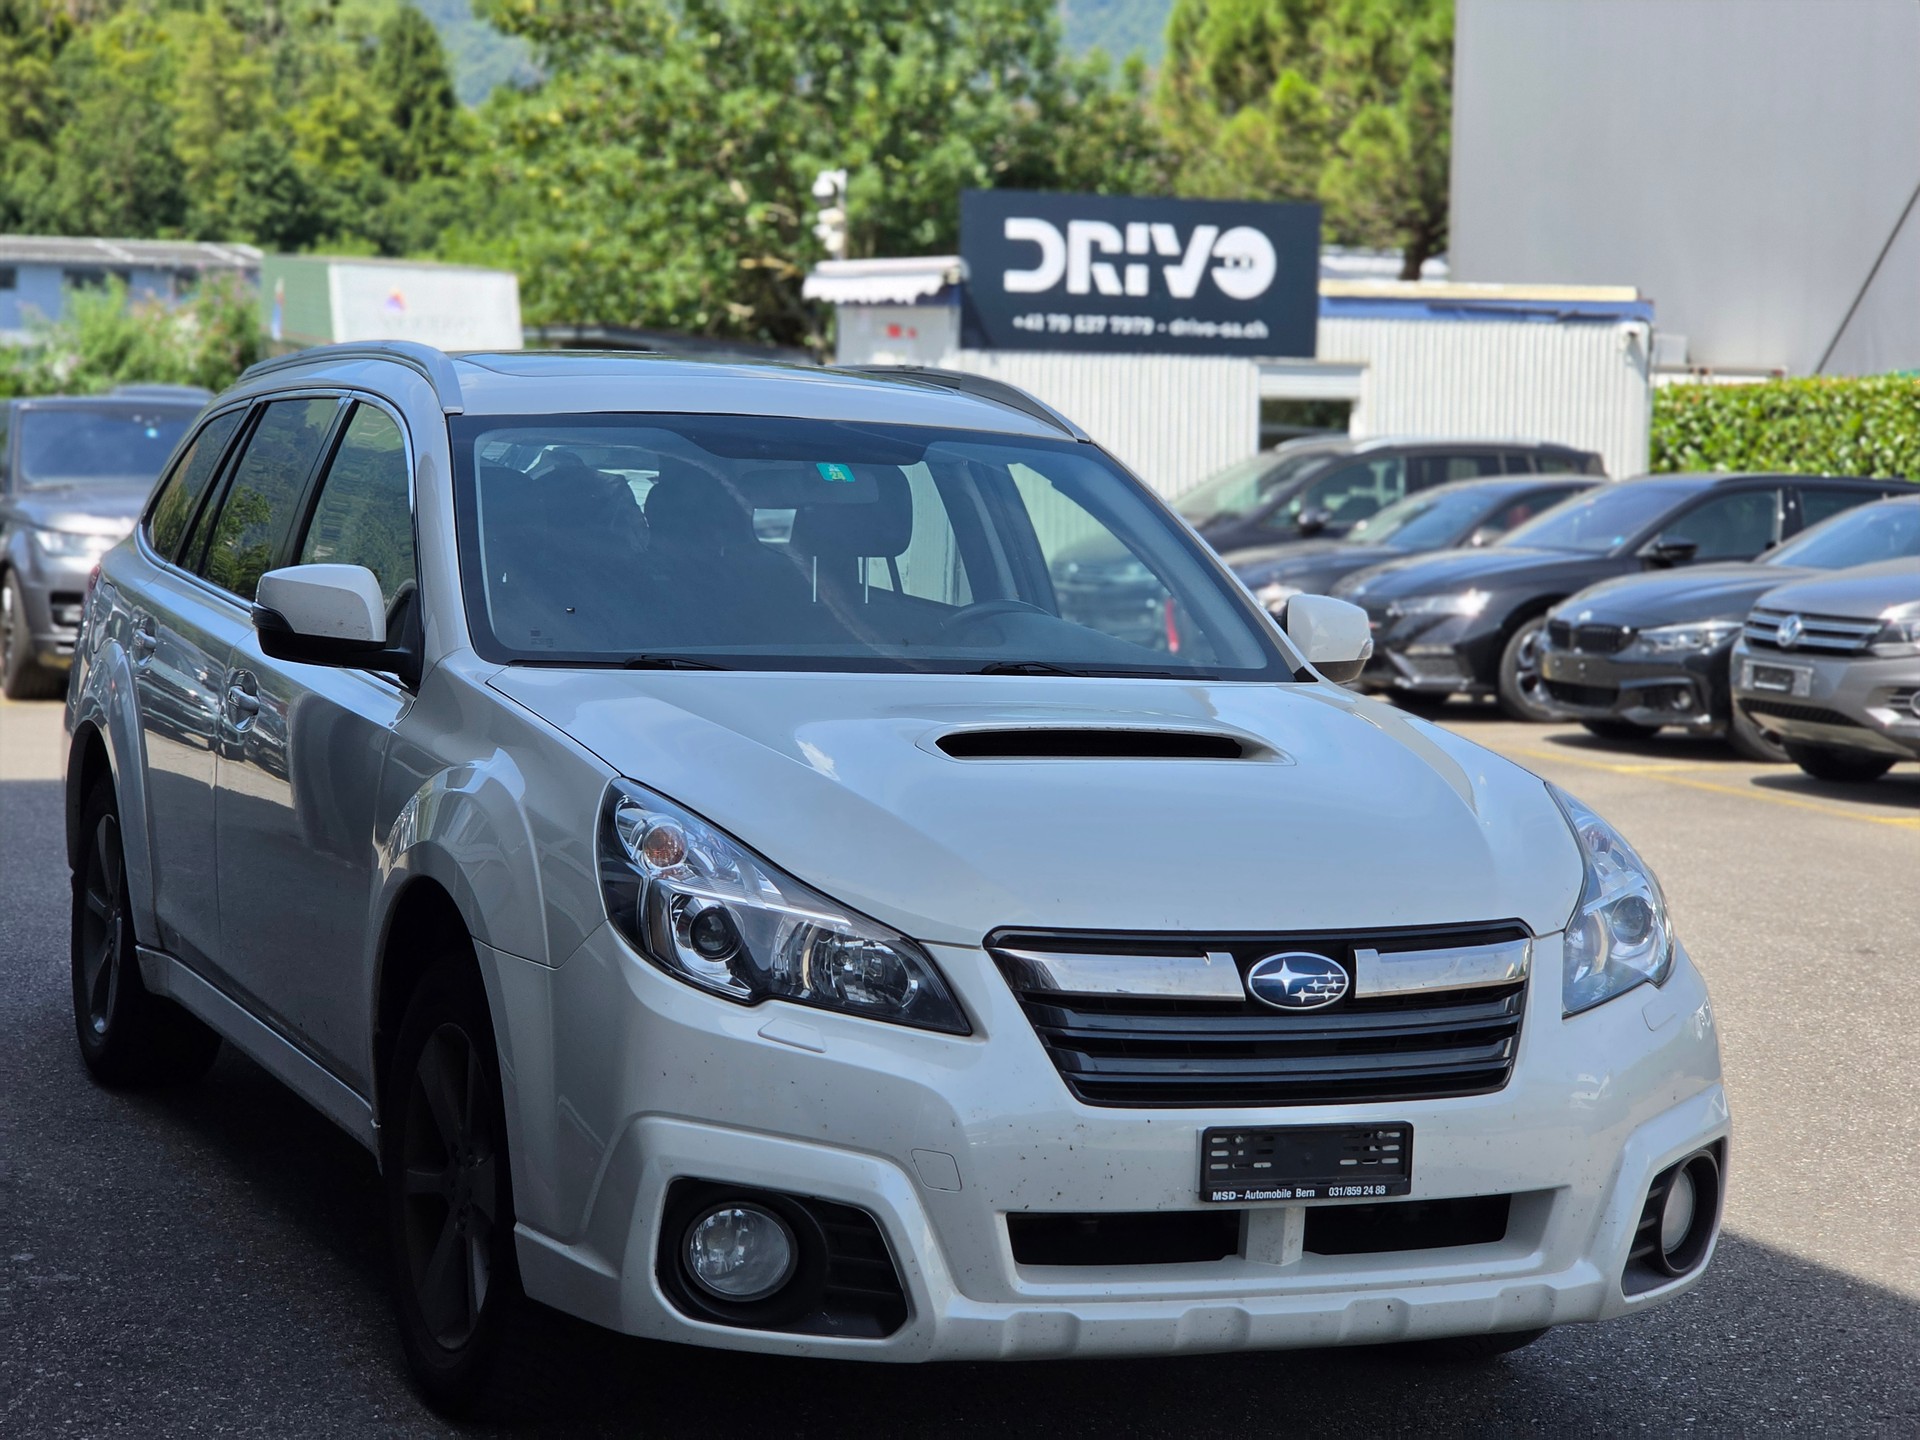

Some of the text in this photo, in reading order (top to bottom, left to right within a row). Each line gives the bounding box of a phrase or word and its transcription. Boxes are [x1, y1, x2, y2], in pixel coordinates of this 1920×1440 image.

[1003, 216, 1277, 300] DRIVO
[1295, 1188, 1315, 1198] Bern
[1328, 1186, 1362, 1197] 031/859
[1363, 1185, 1374, 1196] 24
[1375, 1185, 1386, 1195] 88
